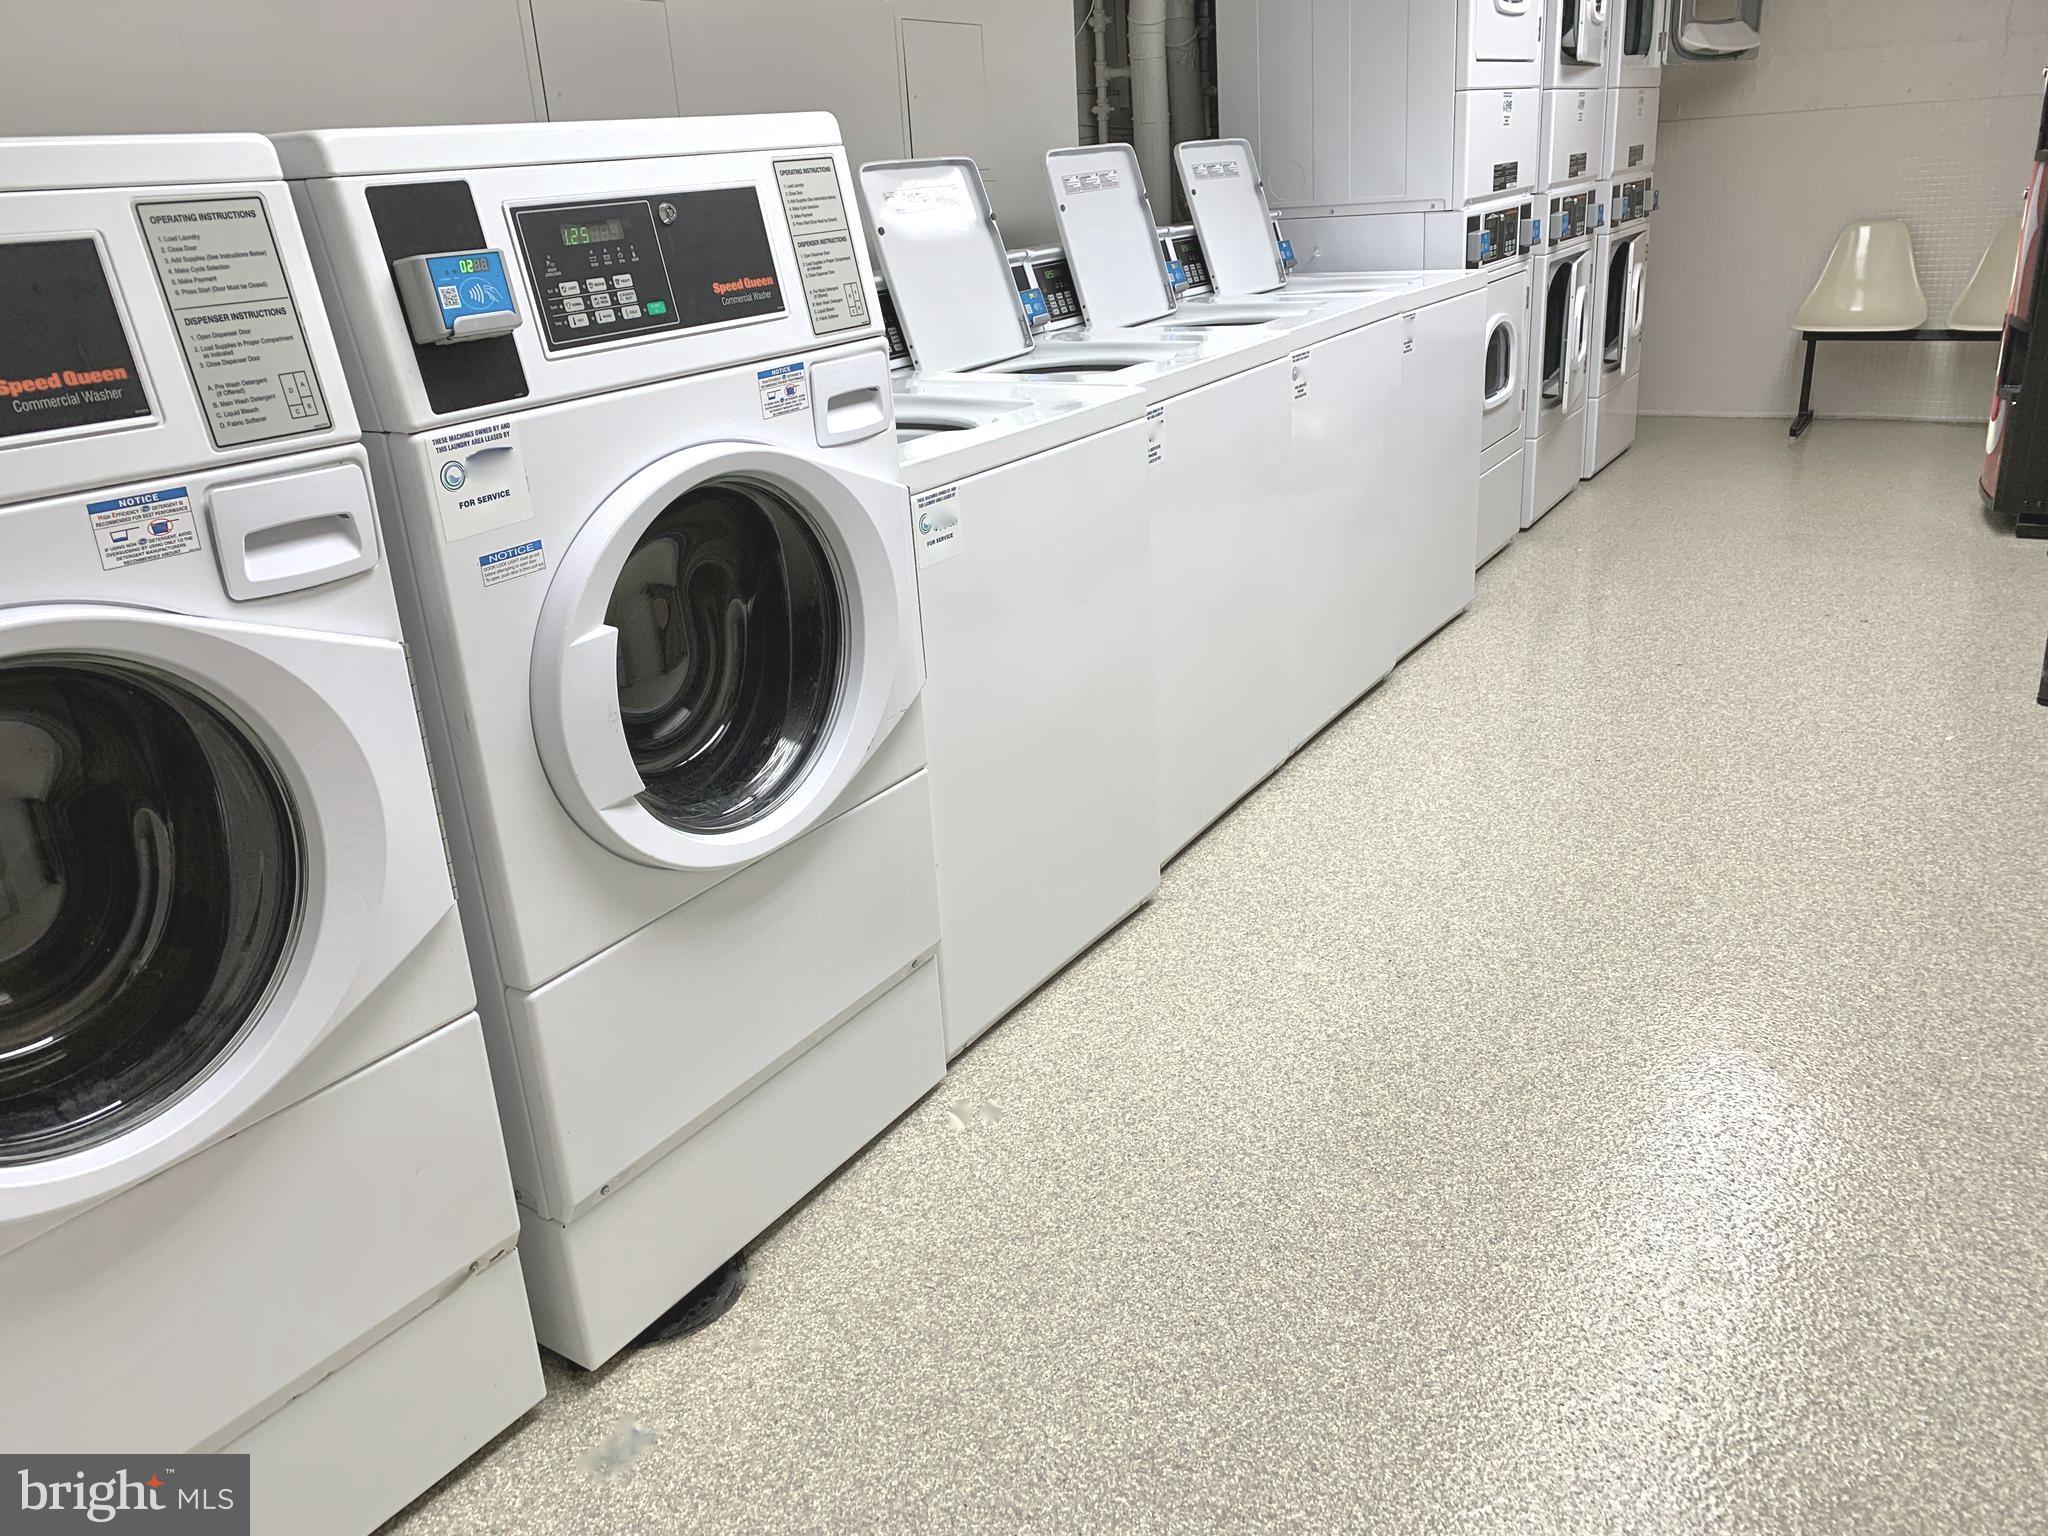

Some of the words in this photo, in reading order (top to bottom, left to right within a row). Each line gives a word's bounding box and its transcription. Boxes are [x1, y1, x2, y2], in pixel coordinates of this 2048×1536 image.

[149, 214, 198, 224] OPERATING
[198, 210, 257, 221] INSTRUCTIONS
[820, 236, 847, 245] INSTRUCTIONS
[193, 276, 218, 284] Payment
[713, 278, 743, 296] Speed
[744, 273, 774, 289] Queen
[722, 292, 753, 306] Commercial
[753, 290, 771, 300] Washer
[183, 314, 230, 326] DISPENSER
[230, 307, 287, 321] INSTRUCTIONS
[212, 330, 238, 339] Dispenser
[214, 342, 237, 351] Supplies
[243, 339, 260, 347] Proper
[260, 335, 294, 345] Compartment
[221, 357, 248, 366] Dispenser
[771, 366, 791, 375] NOTICE
[0, 372, 62, 397] Speed
[62, 368, 128, 386] Queen
[241, 378, 268, 387] Detergent
[12, 392, 80, 413] Commercial
[81, 388, 122, 403] Washer
[250, 394, 277, 404] Detergent
[223, 410, 241, 418] Liquid
[245, 416, 267, 424] Softener
[448, 431, 474, 442] MACHINES
[475, 427, 492, 436] OWNED
[448, 441, 470, 451] LAUNDRY
[484, 433, 503, 442] LEASED
[118, 494, 159, 508] NOTICE
[459, 499, 476, 509] FOR
[477, 490, 511, 504] SERVICE
[96, 517, 131, 527] RECOMMENDED
[155, 506, 188, 516] PERFORMANCE
[111, 509, 139, 518] EFFICIENCY
[151, 502, 178, 510] DETERGENT
[936, 533, 953, 543] SERVICE
[116, 552, 145, 561] DETERGENT
[123, 554, 160, 565] RECOMMENDED
[489, 544, 534, 563] NOTICE
[497, 566, 515, 574] attempting
